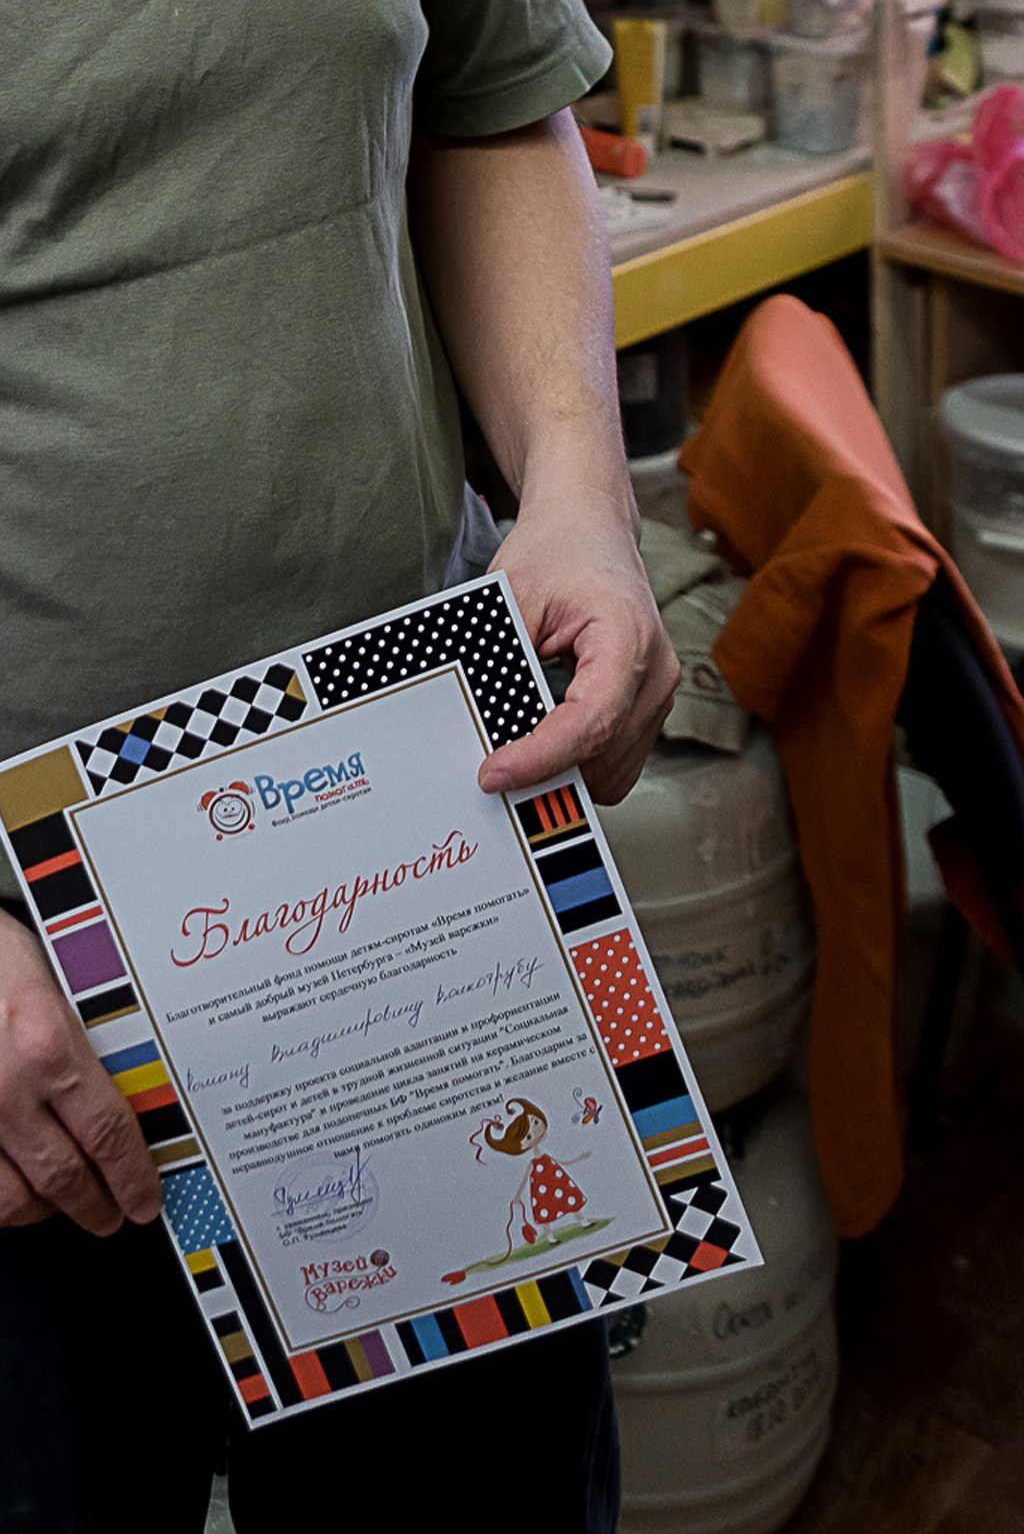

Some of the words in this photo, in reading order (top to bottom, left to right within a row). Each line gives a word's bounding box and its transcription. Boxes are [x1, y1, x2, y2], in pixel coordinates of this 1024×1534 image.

[254, 752, 365, 815] Время
[170, 830, 478, 967] Благодарность
[166, 978, 272, 1023] Благотворительный
[274, 969, 303, 986] фонд
[304, 952, 348, 974] помощи
[351, 923, 430, 960] детям-сиротам
[431, 908, 472, 928] «Время
[474, 888, 530, 913] помогать»
[208, 1017, 216, 1025] и
[218, 1002, 253, 1022] самый
[255, 986, 296, 1010] добрый
[297, 974, 330, 994] музей
[331, 953, 394, 981] Петербурга
[405, 933, 446, 954] «Музей
[448, 917, 499, 940] варежки»
[262, 997, 316, 1023] выражают
[319, 976, 378, 1003] сердечную
[379, 948, 458, 981] благодарность
[221, 1106, 233, 1116] за
[234, 1085, 292, 1111] поддержку
[295, 1071, 338, 1091] проекта
[339, 1046, 401, 1076] социальной
[403, 1028, 459, 1054] адаптации
[461, 1025, 469, 1034] и
[470, 992, 560, 1030] профориентации
[225, 1104, 287, 1131] детей-сирот
[290, 1100, 298, 1109] и
[300, 1088, 330, 1107] детей
[332, 1087, 339, 1095] в
[340, 1069, 385, 1092] трудной
[387, 1048, 446, 1076] жизненной
[448, 1031, 499, 1055] ситуации
[228, 1132, 300, 1160] производстве
[302, 1125, 321, 1139] для
[323, 1102, 389, 1130] подопечных
[389, 1094, 407, 1107] БФ
[510, 1037, 574, 1067] Благодарим
[575, 1032, 588, 1043] за
[319, 1107, 327, 1116] и
[329, 1085, 391, 1112] проведение
[392, 1074, 425, 1090] цикла
[426, 1056, 469, 1079] занятий
[470, 1053, 484, 1064] на
[485, 1025, 562, 1058] керамическом
[231, 1143, 314, 1175] неравнодушное
[316, 1123, 375, 1148] отношение
[377, 1120, 384, 1129] к
[386, 1101, 437, 1125] проблеме
[439, 1083, 493, 1107] сиротства
[494, 1080, 502, 1088] и
[503, 1063, 549, 1086] желание
[551, 1049, 587, 1068] вместе
[589, 1046, 596, 1054] с
[333, 1144, 361, 1159] нами
[363, 1127, 412, 1149] помогать
[414, 1108, 467, 1132] одиноким
[469, 1093, 505, 1114] детям!
